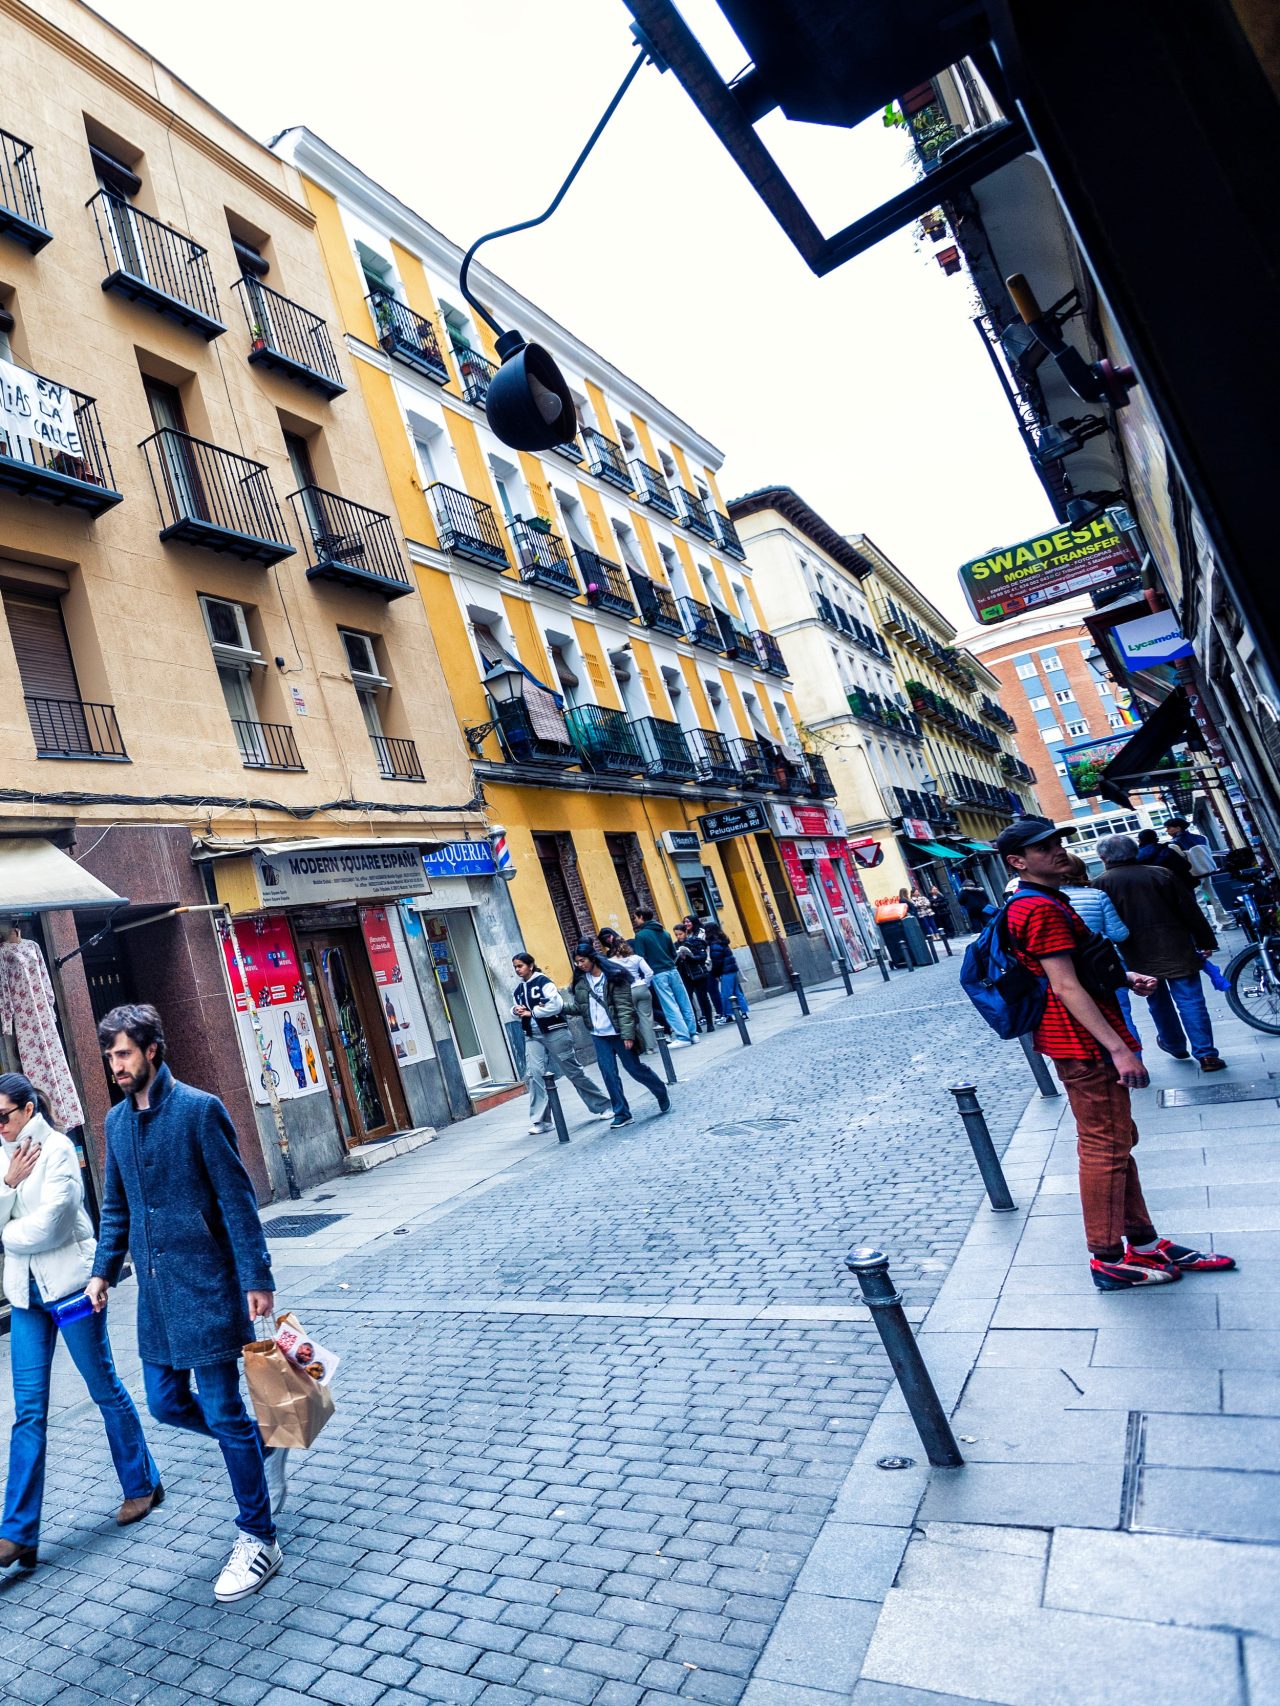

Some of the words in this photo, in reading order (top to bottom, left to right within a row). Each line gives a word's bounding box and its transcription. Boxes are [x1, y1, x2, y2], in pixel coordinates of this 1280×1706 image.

[37, 378, 63, 405] EN
[39, 400, 63, 423] LA
[33, 419, 82, 453] CALLE
[971, 516, 1115, 580] SWADESH
[1004, 561, 1048, 582] MONEY
[1051, 536, 1120, 566] TRANSFER
[289, 857, 338, 875] MODERN
[340, 854, 381, 874] SQUARE
[531, 986, 541, 999] C
